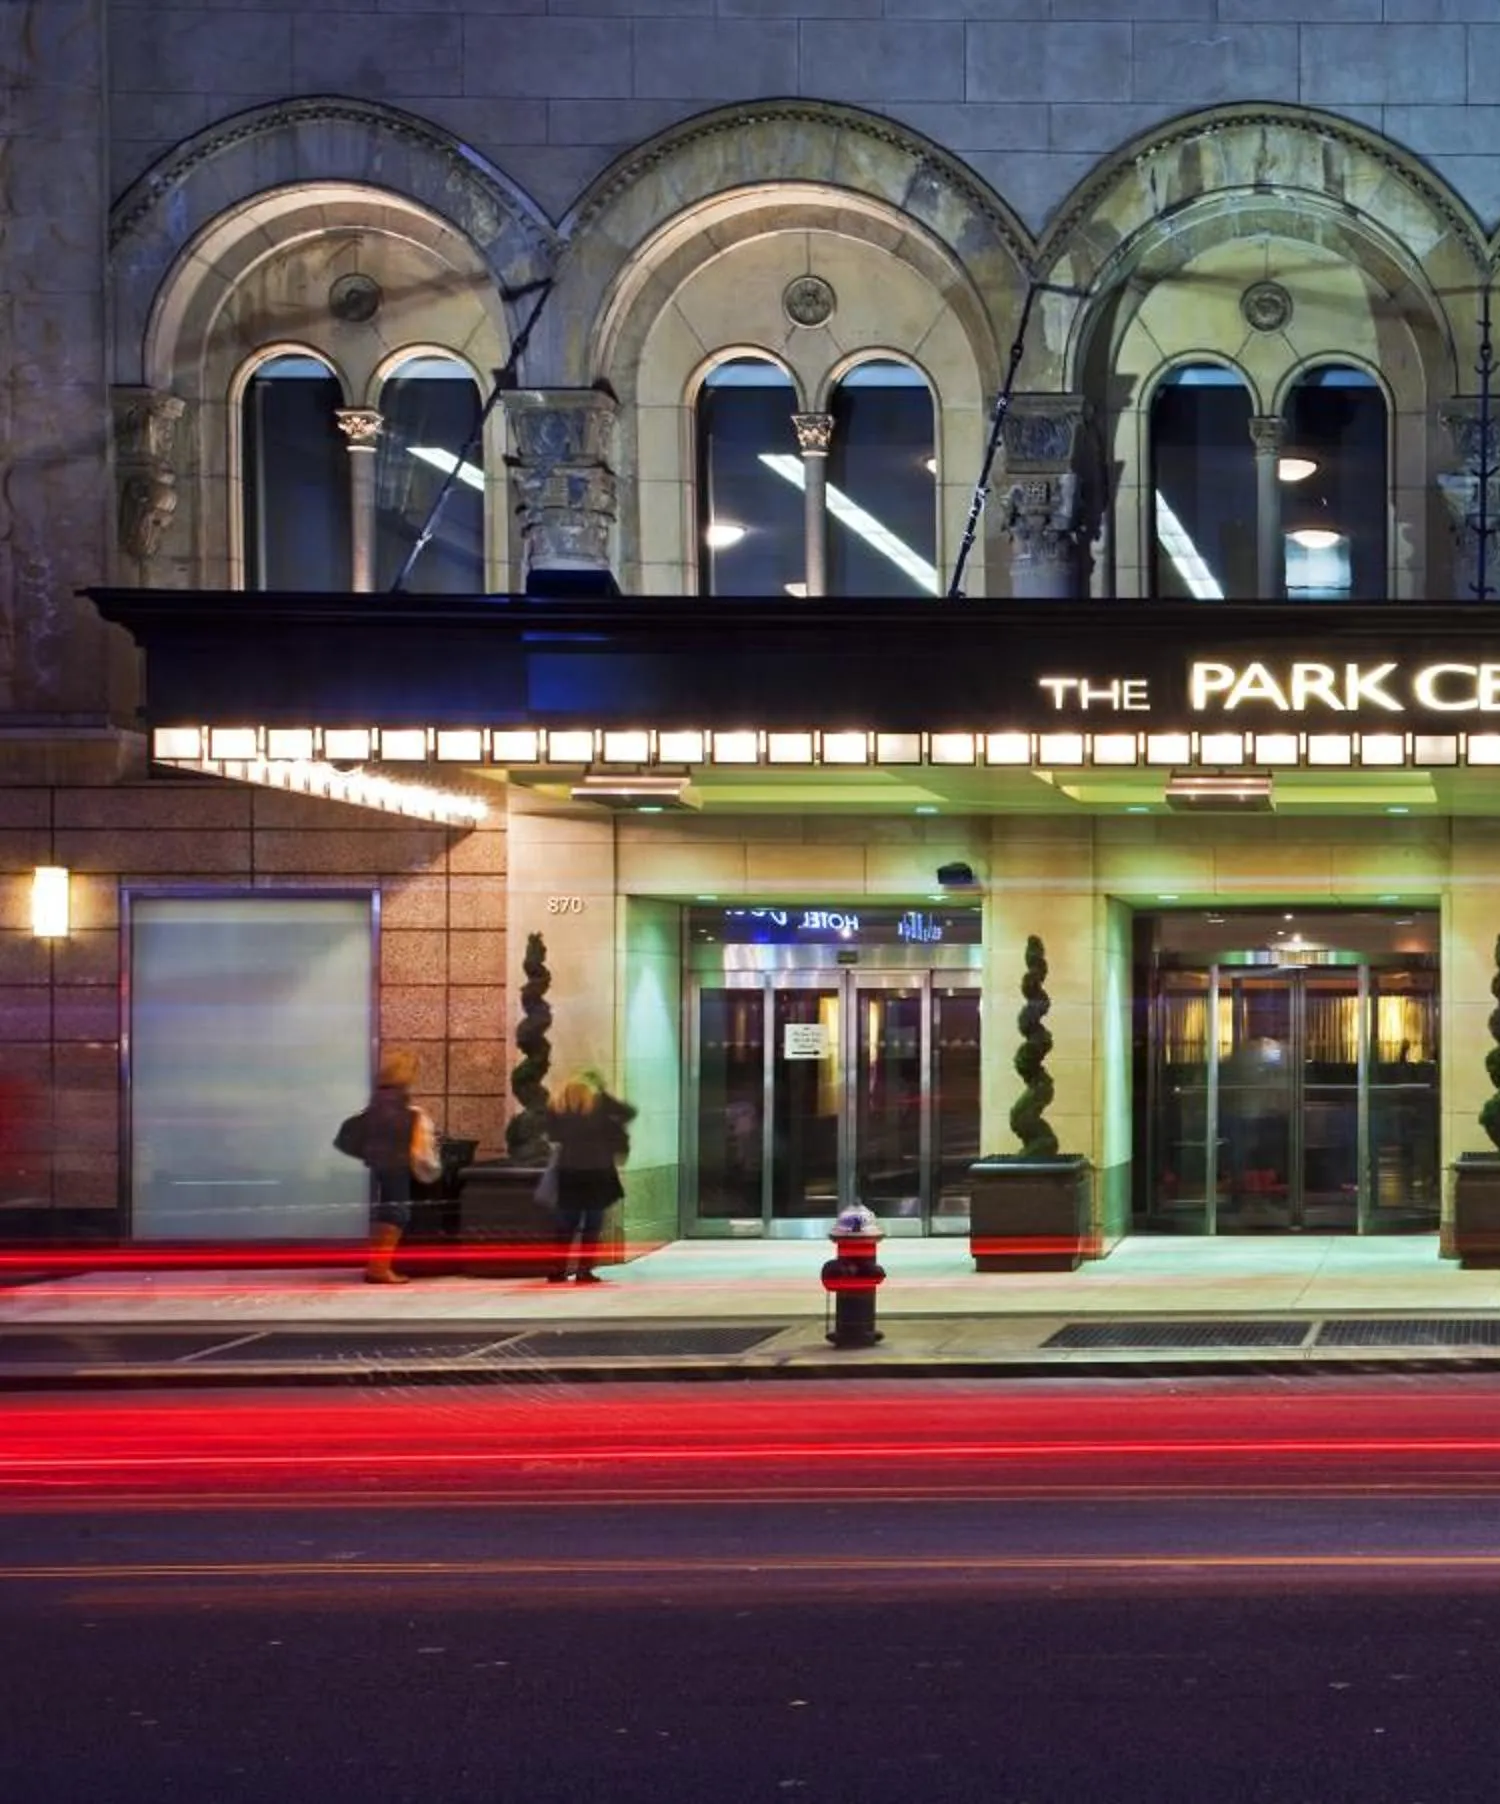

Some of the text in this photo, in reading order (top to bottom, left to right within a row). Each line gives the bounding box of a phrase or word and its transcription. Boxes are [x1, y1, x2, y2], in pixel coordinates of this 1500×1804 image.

[1038, 677, 1151, 711] THE
[1188, 661, 1406, 712] PARK
[547, 896, 582, 914] 870
